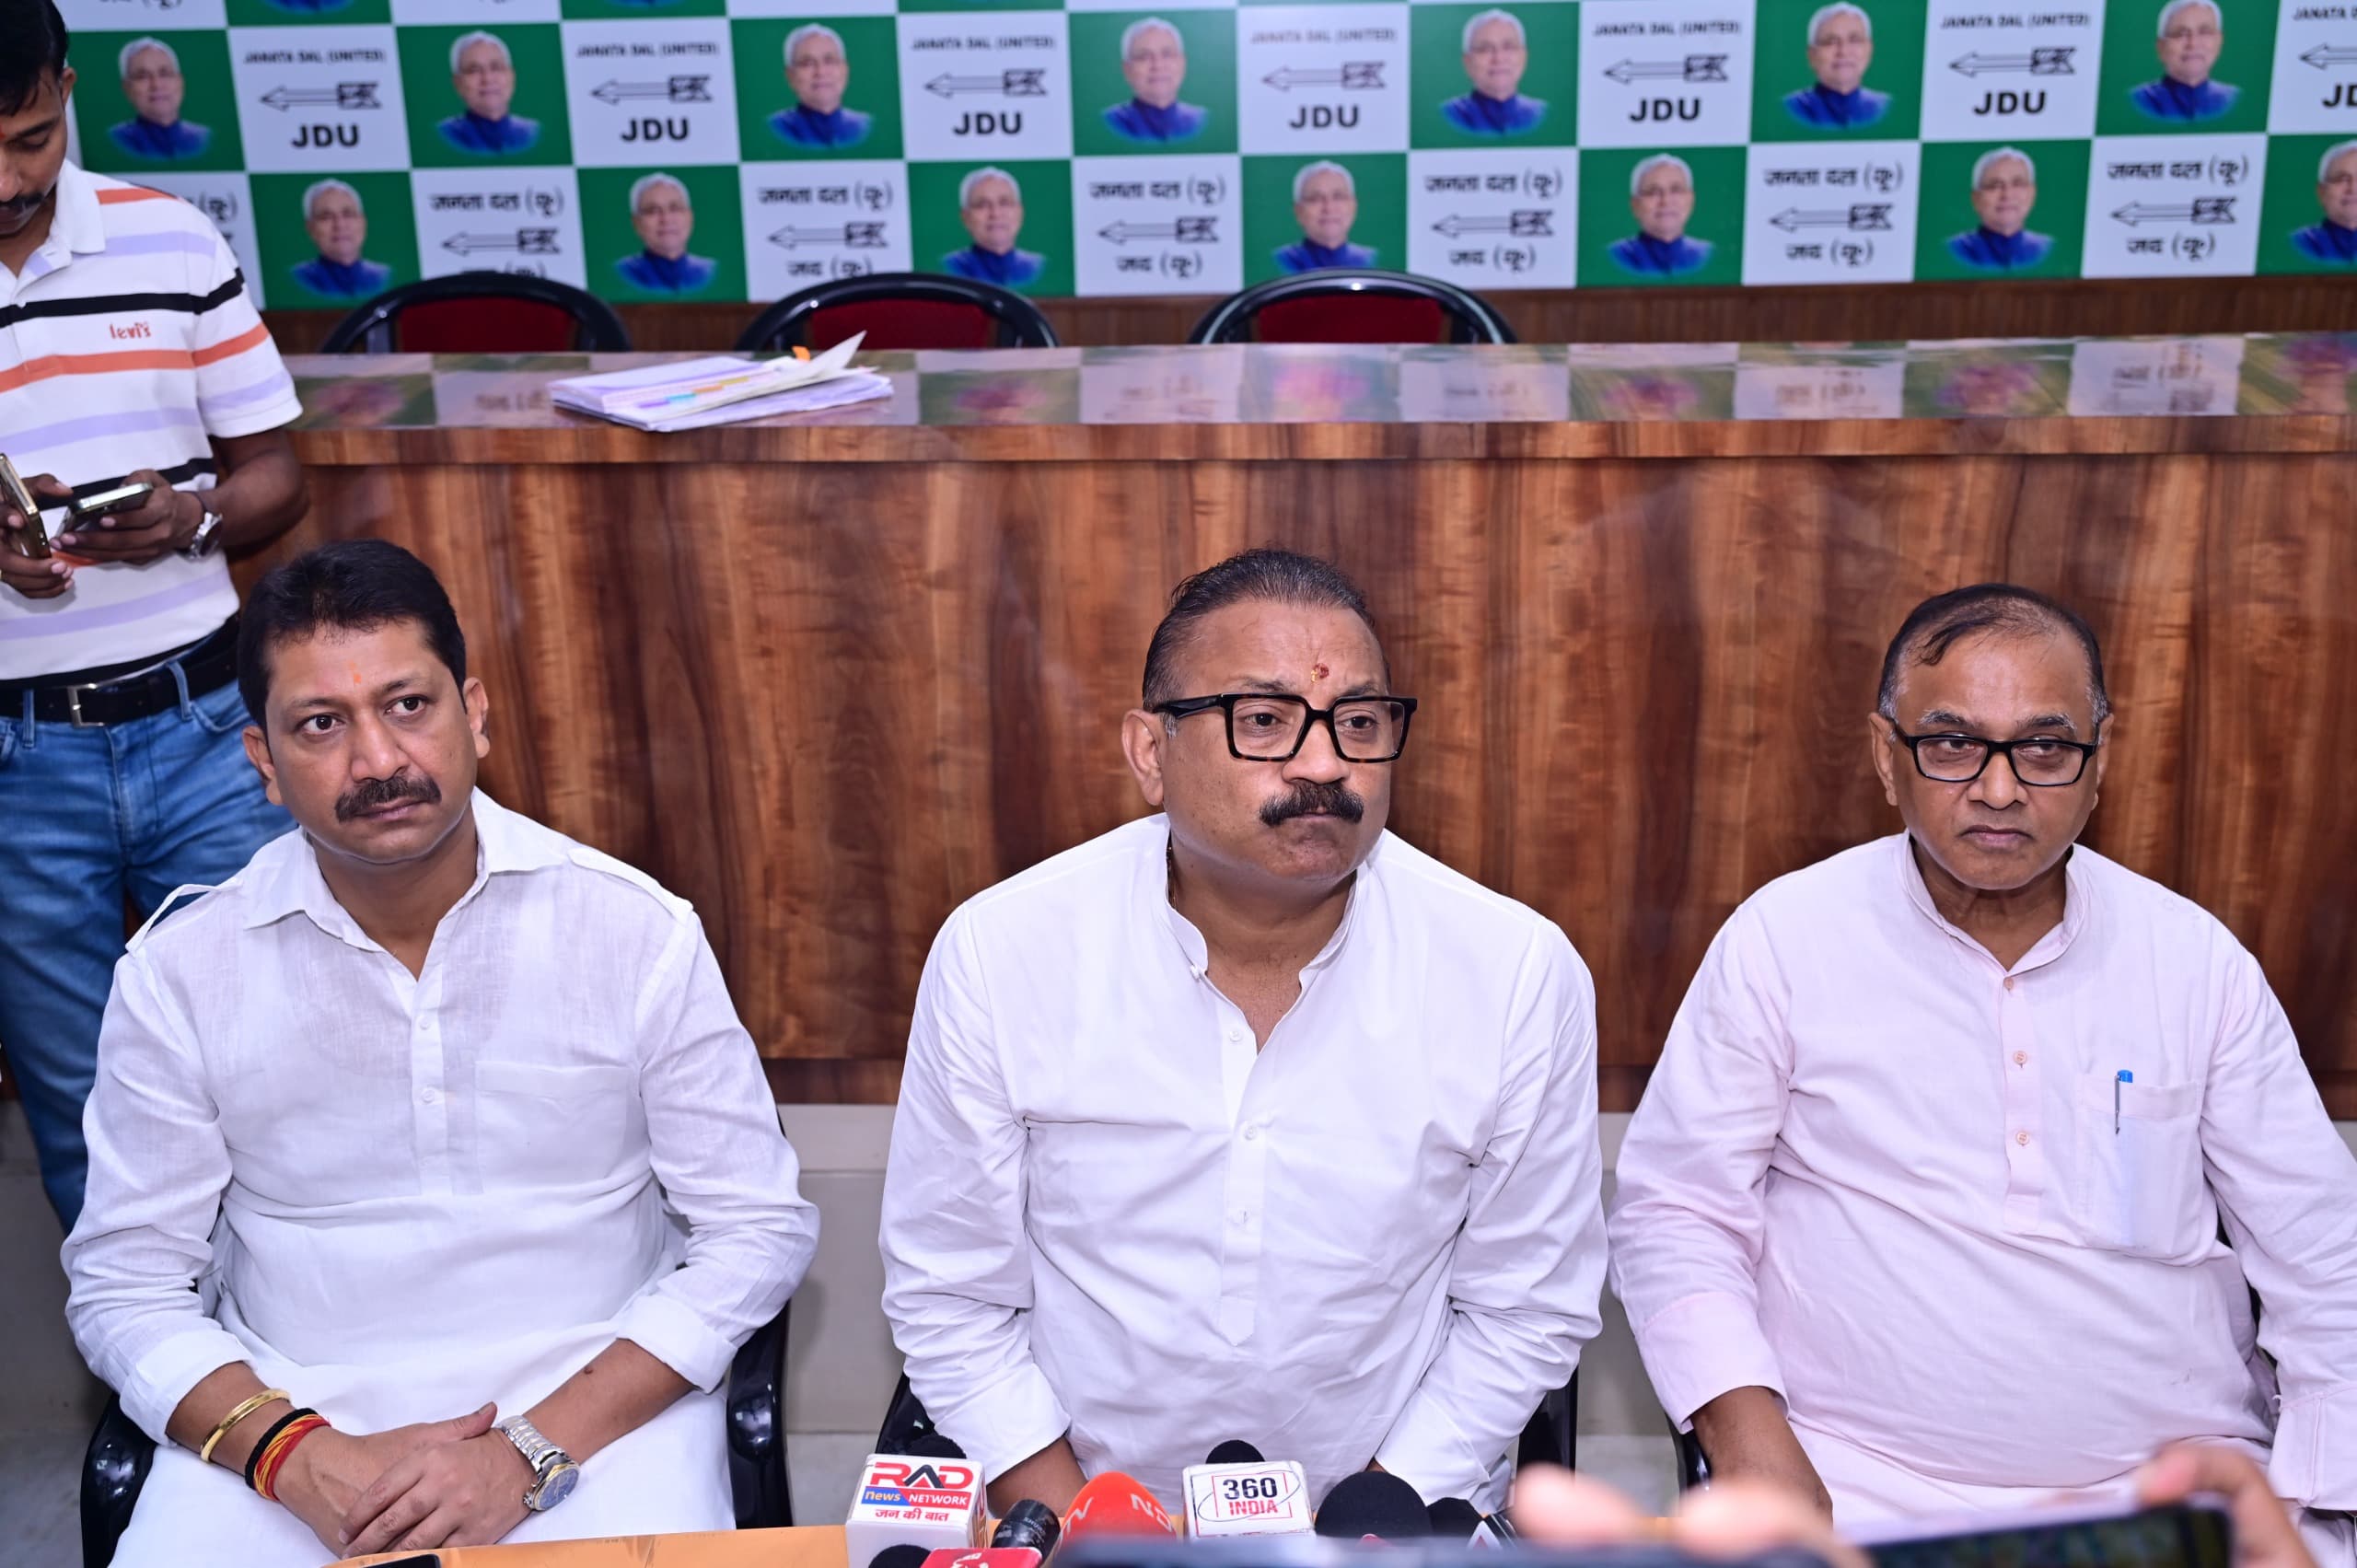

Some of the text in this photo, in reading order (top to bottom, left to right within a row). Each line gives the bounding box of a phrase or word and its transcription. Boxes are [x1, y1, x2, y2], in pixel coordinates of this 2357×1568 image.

[1628, 97, 1701, 123] JDU
[1972, 89, 2048, 116] JDU
[620, 117, 690, 143] JDU
[952, 110, 1023, 136] JDU
[1289, 104, 1360, 130] JDU
[291, 123, 360, 149] JDU
[870, 1462, 974, 1490] RAD
[1223, 1477, 1278, 1500] 360
[865, 1491, 968, 1505] news NETWORK
[1229, 1500, 1279, 1516] INDIA
[876, 1507, 950, 1522] जन की बात
